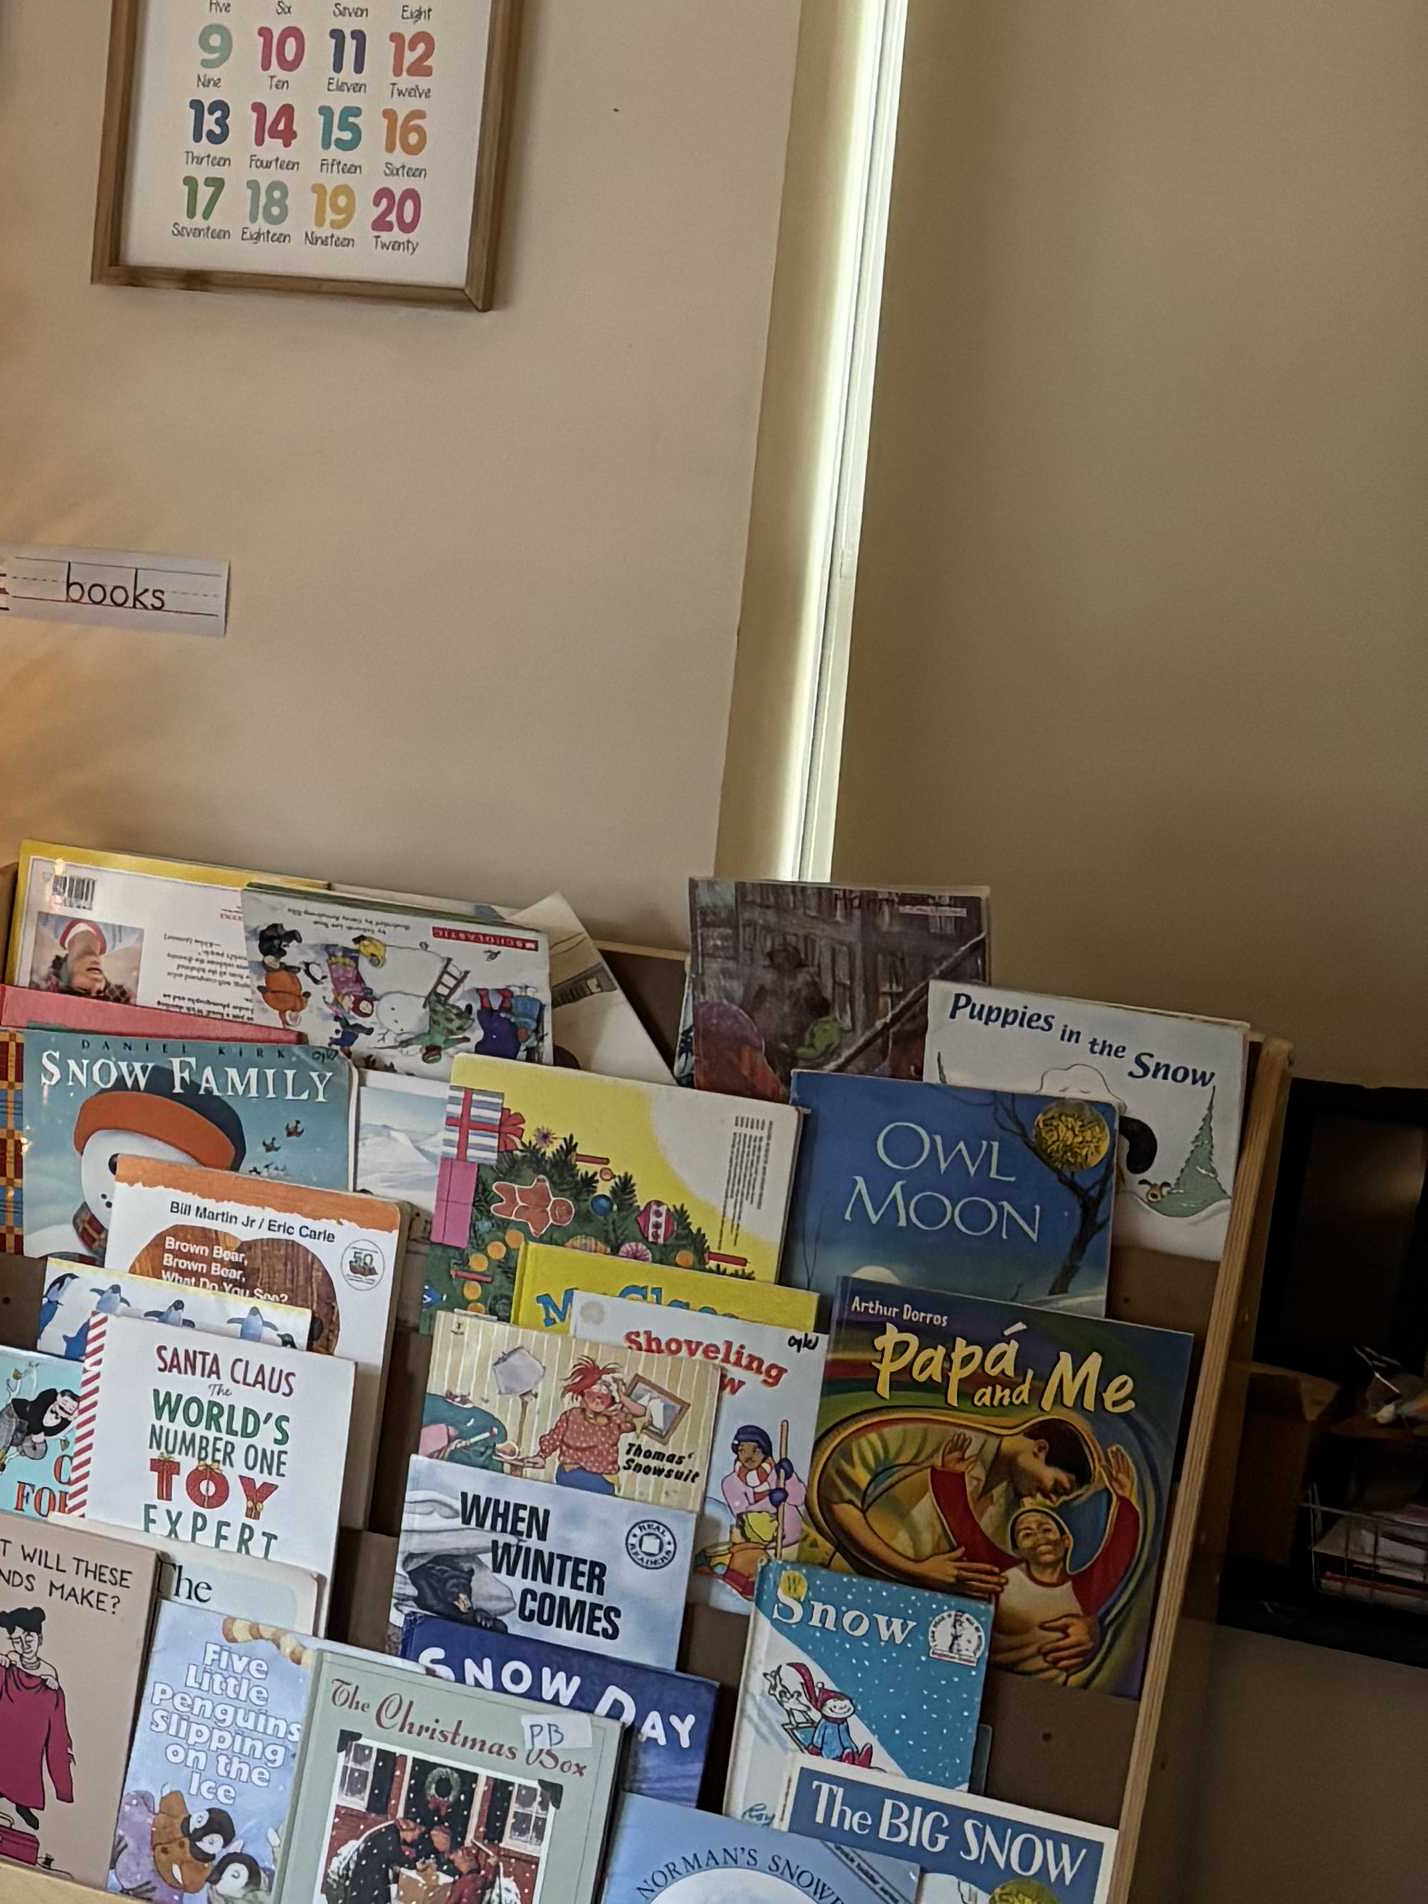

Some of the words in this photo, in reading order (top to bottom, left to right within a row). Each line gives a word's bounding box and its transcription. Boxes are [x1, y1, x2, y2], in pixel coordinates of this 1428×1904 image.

[276, 1, 293, 16] Six
[333, 2, 369, 18] Seven
[401, 4, 432, 24] Eight
[198, 24, 233, 69] 9
[257, 25, 305, 72] 10
[329, 28, 367, 74] 11
[389, 31, 436, 78] 12
[197, 74, 221, 90] Nine
[268, 75, 289, 91] Ten
[327, 78, 367, 94] Eleven
[390, 84, 431, 100] Twelve
[189, 99, 230, 145] 13
[251, 102, 297, 148] 14
[318, 105, 362, 151] 15
[382, 108, 427, 156] 16
[184, 151, 231, 168] Thirteen
[249, 154, 300, 172] Fourteen
[319, 158, 362, 175] Fifteen
[384, 162, 427, 179] Sixteen
[182, 175, 225, 220] 17
[246, 179, 289, 226] 18
[311, 183, 356, 230] 19
[370, 187, 422, 234] 20
[172, 224, 231, 241] Seventeen
[241, 227, 291, 245] Eighteen
[304, 231, 355, 249] Nineteen
[372, 235, 419, 255] Twenty
[66, 561, 165, 610] books
[948, 991, 1055, 1036] Puppies
[1059, 1022, 1082, 1045] in
[1088, 1036, 1127, 1062] the
[1127, 1049, 1217, 1090] Snow
[40, 1049, 166, 1092] SNOW
[167, 1056, 334, 1103] FAMILY
[875, 1120, 1018, 1184] OWL
[169, 1200, 192, 1216] Bill
[195, 1204, 239, 1225] Martin
[242, 1215, 256, 1229] Jr
[267, 1218, 294, 1236] Eric
[298, 1225, 336, 1243] Carle
[843, 1174, 1042, 1245] MOON
[162, 1253, 208, 1274] Brown
[211, 1263, 246, 1283] Bear,
[164, 1236, 209, 1257] Brown
[213, 1246, 248, 1266] Bear,
[851, 1295, 900, 1323] Arthur
[902, 1296, 950, 1328] Dorros
[156, 1345, 221, 1381] SANTA
[230, 1357, 296, 1397] CLAUS
[623, 1330, 788, 1388] Shoveling
[872, 1320, 1027, 1405] Papá
[974, 1368, 1033, 1409] and
[1041, 1350, 1137, 1415] Me
[152, 1388, 290, 1446] WORLD'S
[148, 1424, 235, 1468] NUMBER
[244, 1444, 288, 1478] ONE
[621, 1456, 701, 1485] Snowsuit
[149, 1454, 279, 1521] TOY
[142, 1503, 279, 1561] EXPERT
[459, 1490, 551, 1543] WHEN
[19, 1545, 67, 1574] WILL
[72, 1555, 134, 1590] THESE
[490, 1539, 608, 1597] WINTER
[47, 1581, 122, 1617] MAKE?
[517, 1587, 622, 1642] COMES
[772, 1587, 918, 1646] Snow
[184, 1664, 269, 1706] Little
[202, 1641, 269, 1681] Five
[150, 1682, 302, 1742] Penguins
[418, 1646, 582, 1708] SNOW
[592, 1684, 697, 1749] DAY
[149, 1708, 286, 1770] Slipping
[328, 1678, 372, 1714] The
[374, 1691, 517, 1762] Christmas
[525, 1737, 589, 1778] Box
[528, 1721, 565, 1747] PB
[164, 1744, 207, 1772] on
[215, 1751, 271, 1787] the
[187, 1771, 237, 1806] Ice
[811, 1779, 874, 1836] The
[876, 1798, 952, 1854] BIG
[959, 1817, 1089, 1888] SNOW
[635, 1846, 759, 1901] NORMAN'S
